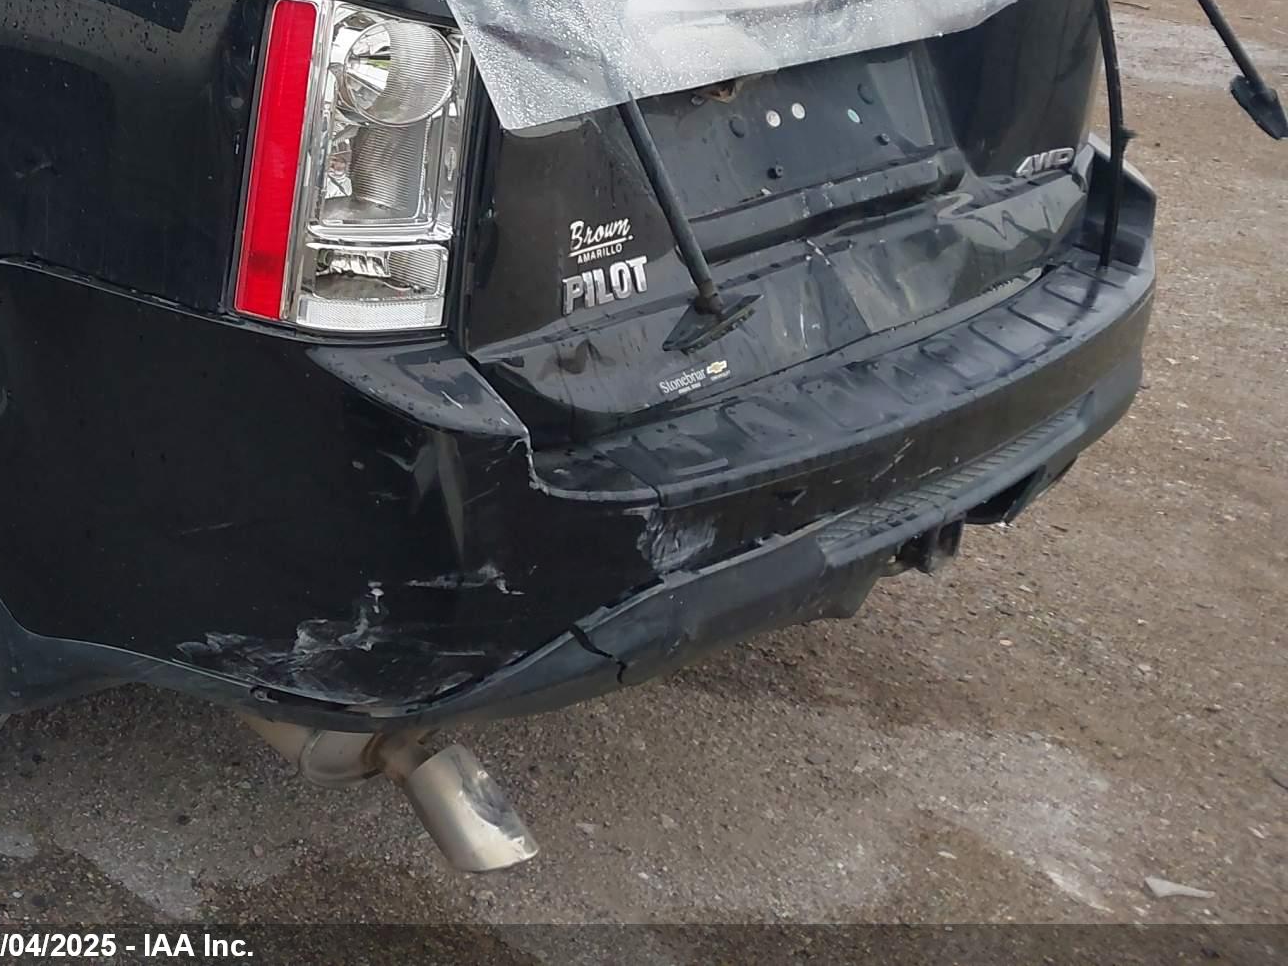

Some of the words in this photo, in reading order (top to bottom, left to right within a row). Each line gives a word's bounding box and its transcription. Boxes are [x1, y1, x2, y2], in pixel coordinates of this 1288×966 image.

[1016, 147, 1074, 179] 4WD
[570, 219, 631, 251] Brown
[577, 243, 623, 264] AMARILLO
[562, 255, 648, 316] PILOT
[659, 368, 706, 394] Stonebriar
